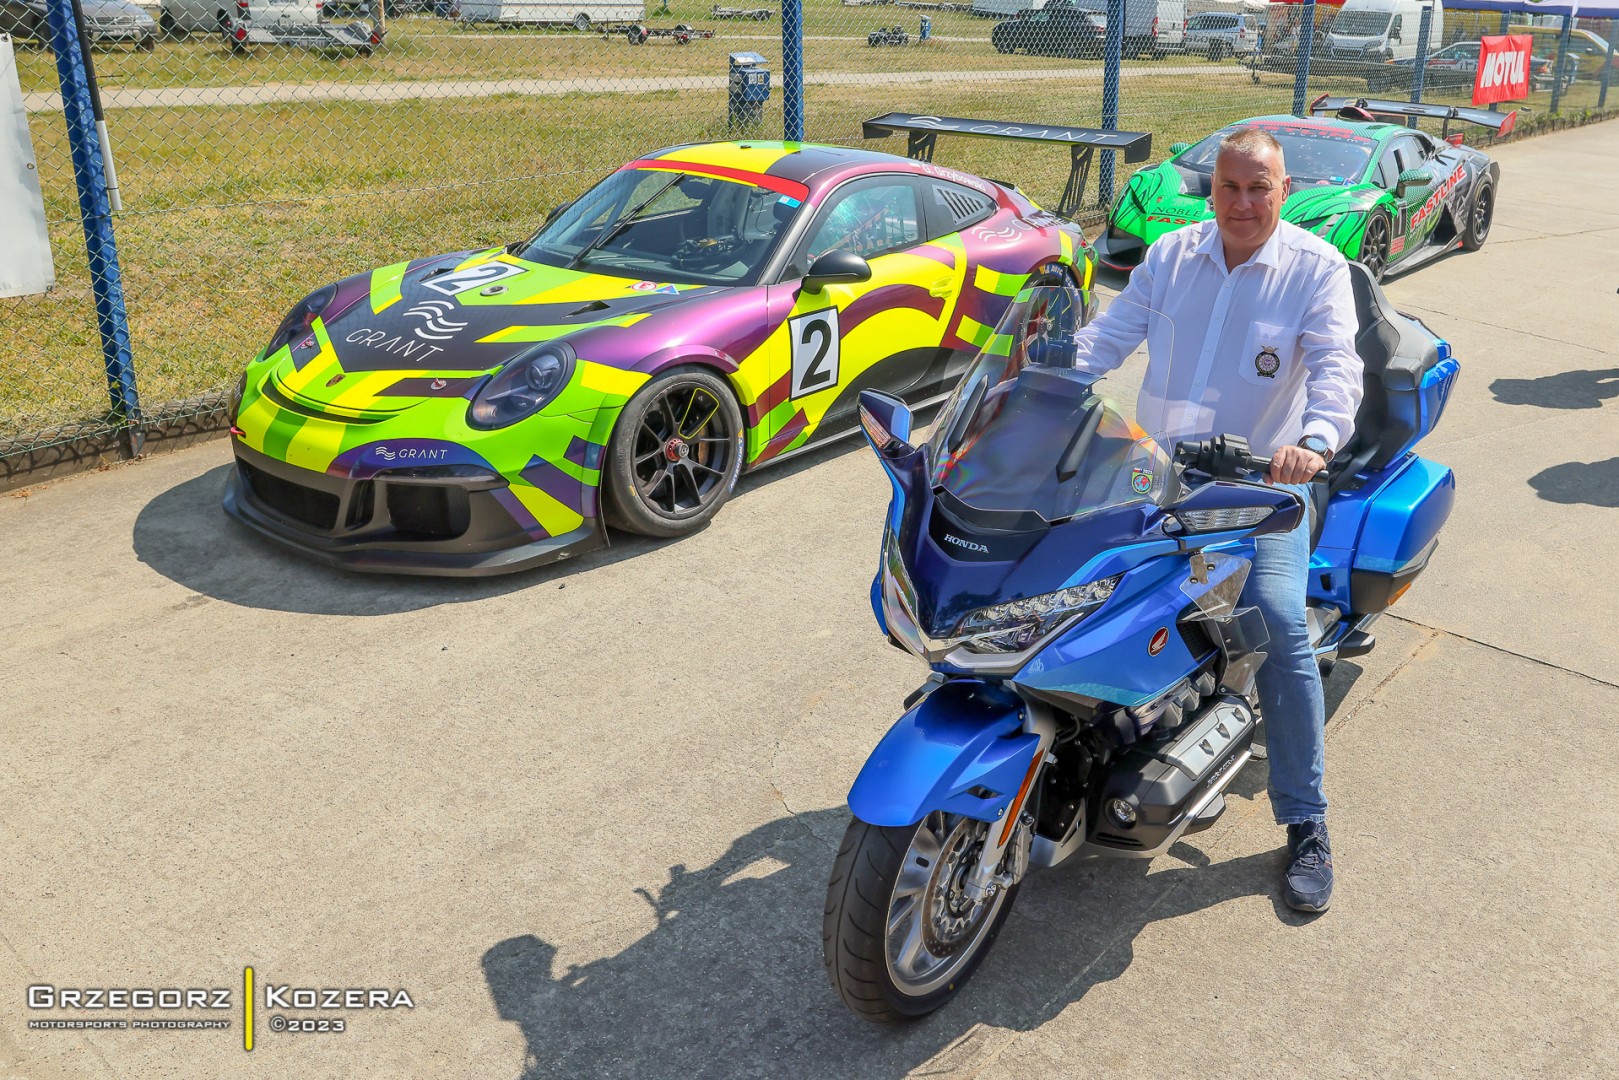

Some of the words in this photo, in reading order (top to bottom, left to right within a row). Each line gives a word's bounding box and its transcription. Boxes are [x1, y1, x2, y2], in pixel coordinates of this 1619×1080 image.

[1480, 51, 1526, 88] MOTUL
[968, 125, 1118, 141] GRANT
[1153, 206, 1203, 217] NOBLE
[1410, 165, 1467, 231] FASTLINE
[431, 265, 510, 292] 2
[345, 328, 444, 362] GRANT
[799, 319, 832, 391] 2
[399, 448, 448, 460] GRANT
[943, 533, 990, 553] HONDA
